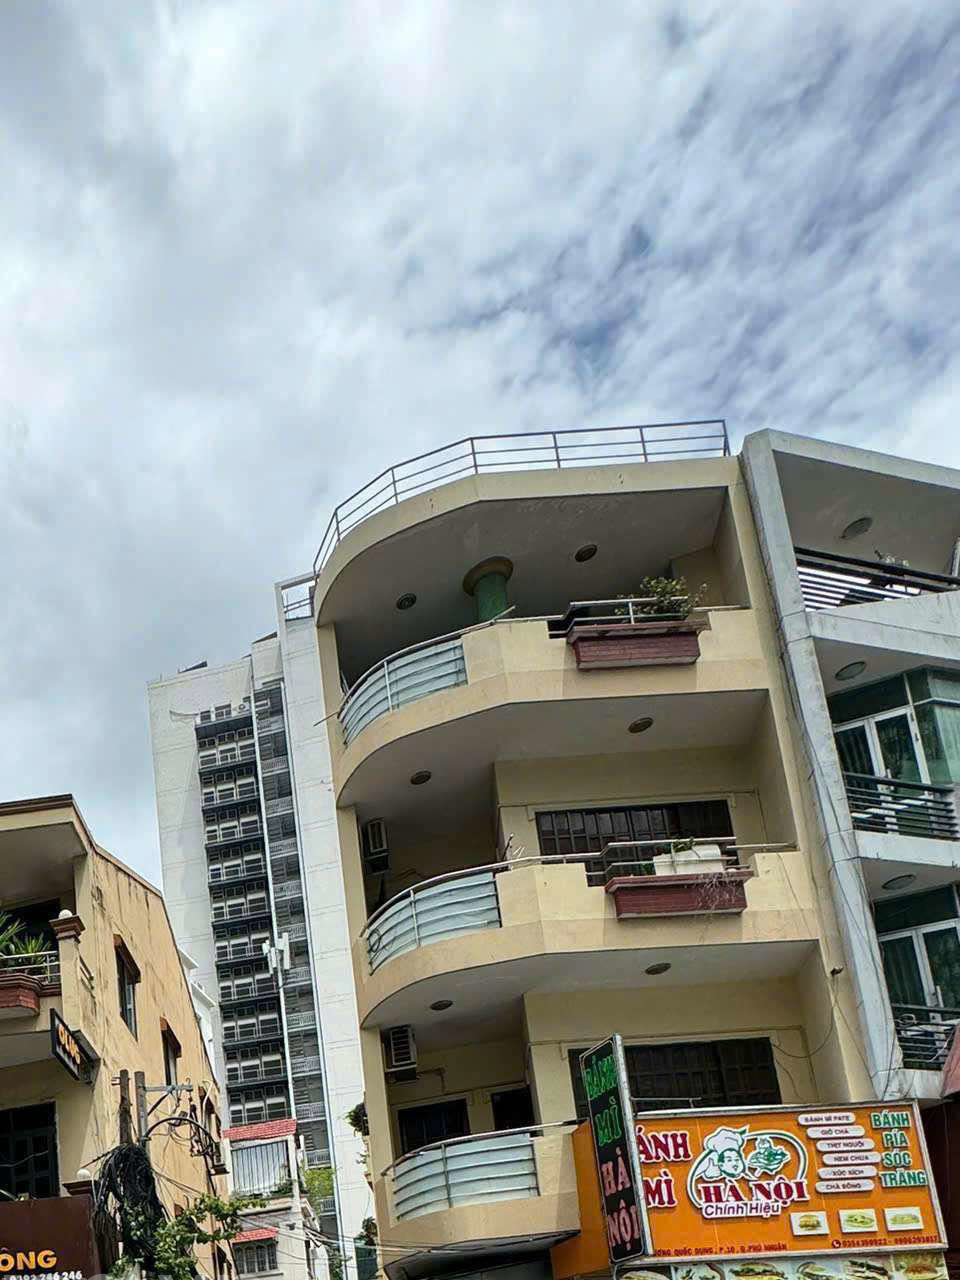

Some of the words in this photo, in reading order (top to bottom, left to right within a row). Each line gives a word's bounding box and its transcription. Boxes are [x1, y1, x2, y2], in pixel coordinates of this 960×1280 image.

[872, 1109, 910, 1127] BÁNH
[636, 1126, 690, 1161] ÁNH
[884, 1128, 908, 1147] PÍA
[884, 1148, 912, 1166] SÓC
[880, 1167, 926, 1186] TRĂNG
[642, 1170, 676, 1206] MÌ
[700, 1178, 745, 1203] HÀ
[750, 1177, 808, 1205] NỘI
[704, 1203, 745, 1216] Chính
[749, 1202, 780, 1218] Hiệu
[608, 1199, 641, 1251] NỘI
